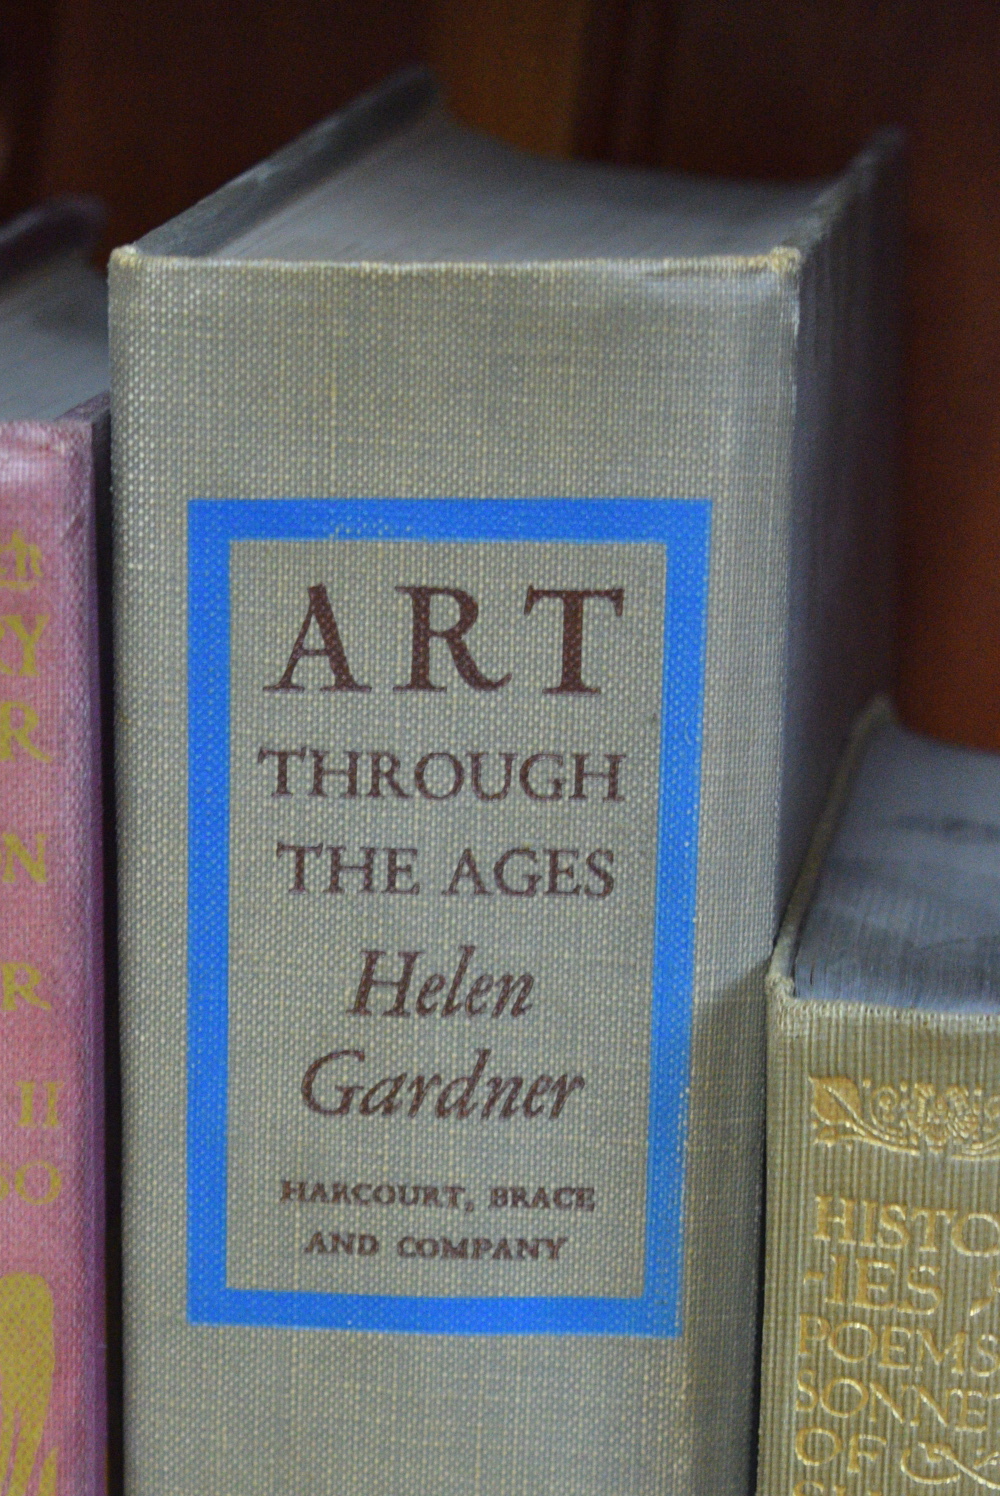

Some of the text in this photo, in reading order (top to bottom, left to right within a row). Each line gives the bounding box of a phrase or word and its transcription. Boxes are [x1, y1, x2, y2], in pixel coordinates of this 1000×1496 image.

[262, 583, 625, 694] ART
[257, 746, 627, 801] THROUGH
[276, 842, 615, 898] THE AGES
[346, 945, 535, 1018] Helen
[16, 1080, 64, 1128] II
[300, 1049, 586, 1120] Gardner
[281, 1180, 595, 1212] HARCOURT, BRACE
[304, 1231, 569, 1260] AND COMPANY
[798, 1314, 1000, 1377] POEMS
[796, 1370, 1000, 1433] SONNE
[794, 1428, 888, 1474] OF
